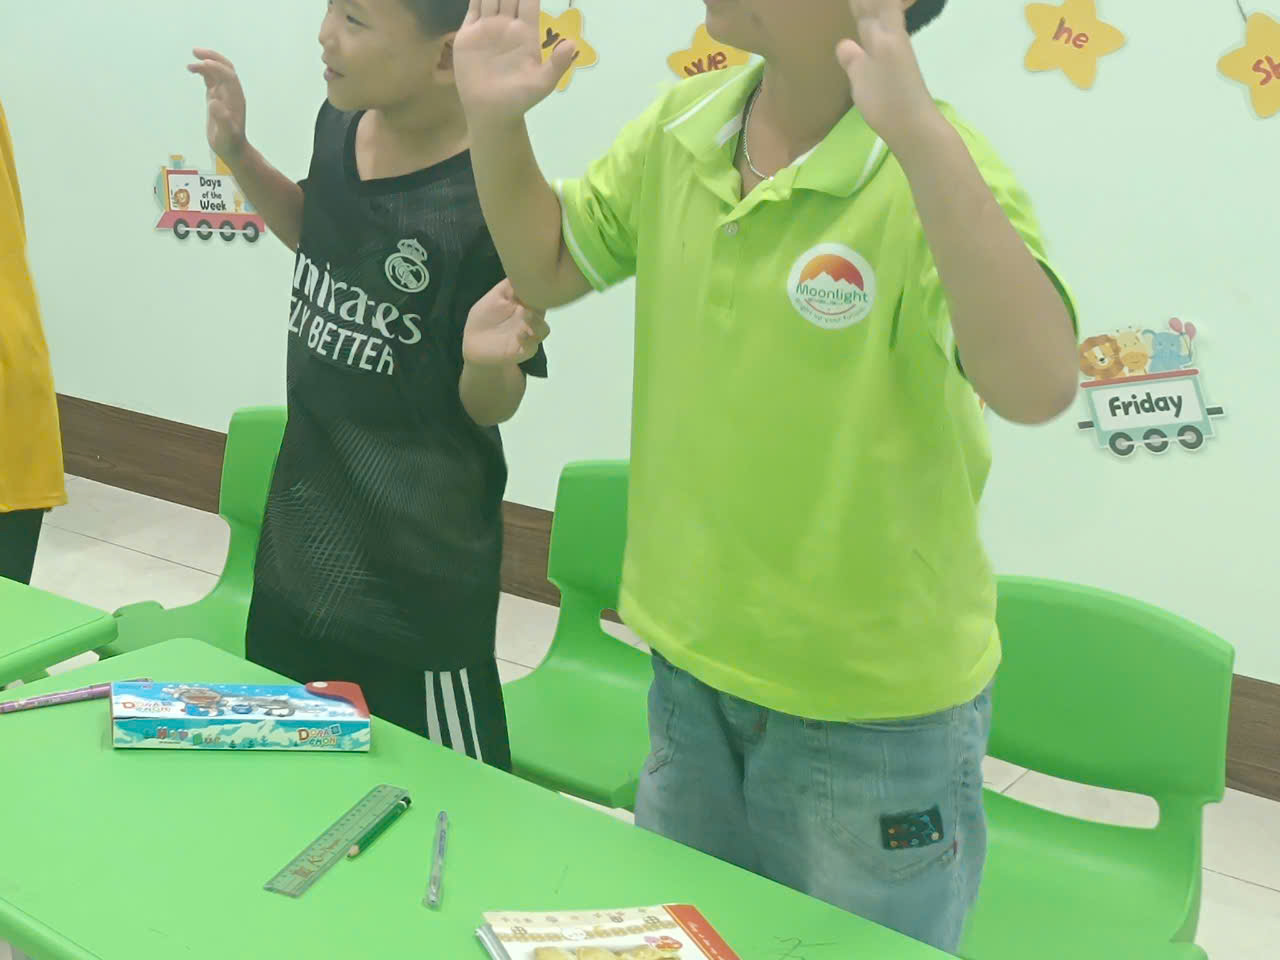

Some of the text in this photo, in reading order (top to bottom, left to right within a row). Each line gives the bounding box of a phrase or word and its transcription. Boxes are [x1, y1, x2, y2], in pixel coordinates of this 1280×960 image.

[1052, 17, 1089, 50] he
[200, 176, 222, 190] Days
[200, 200, 227, 211] Week
[202, 191, 222, 199] of the
[293, 243, 422, 344] miraes
[796, 283, 868, 304] Moonlight
[307, 315, 395, 375] BETTER
[1108, 392, 1182, 418] Friday
